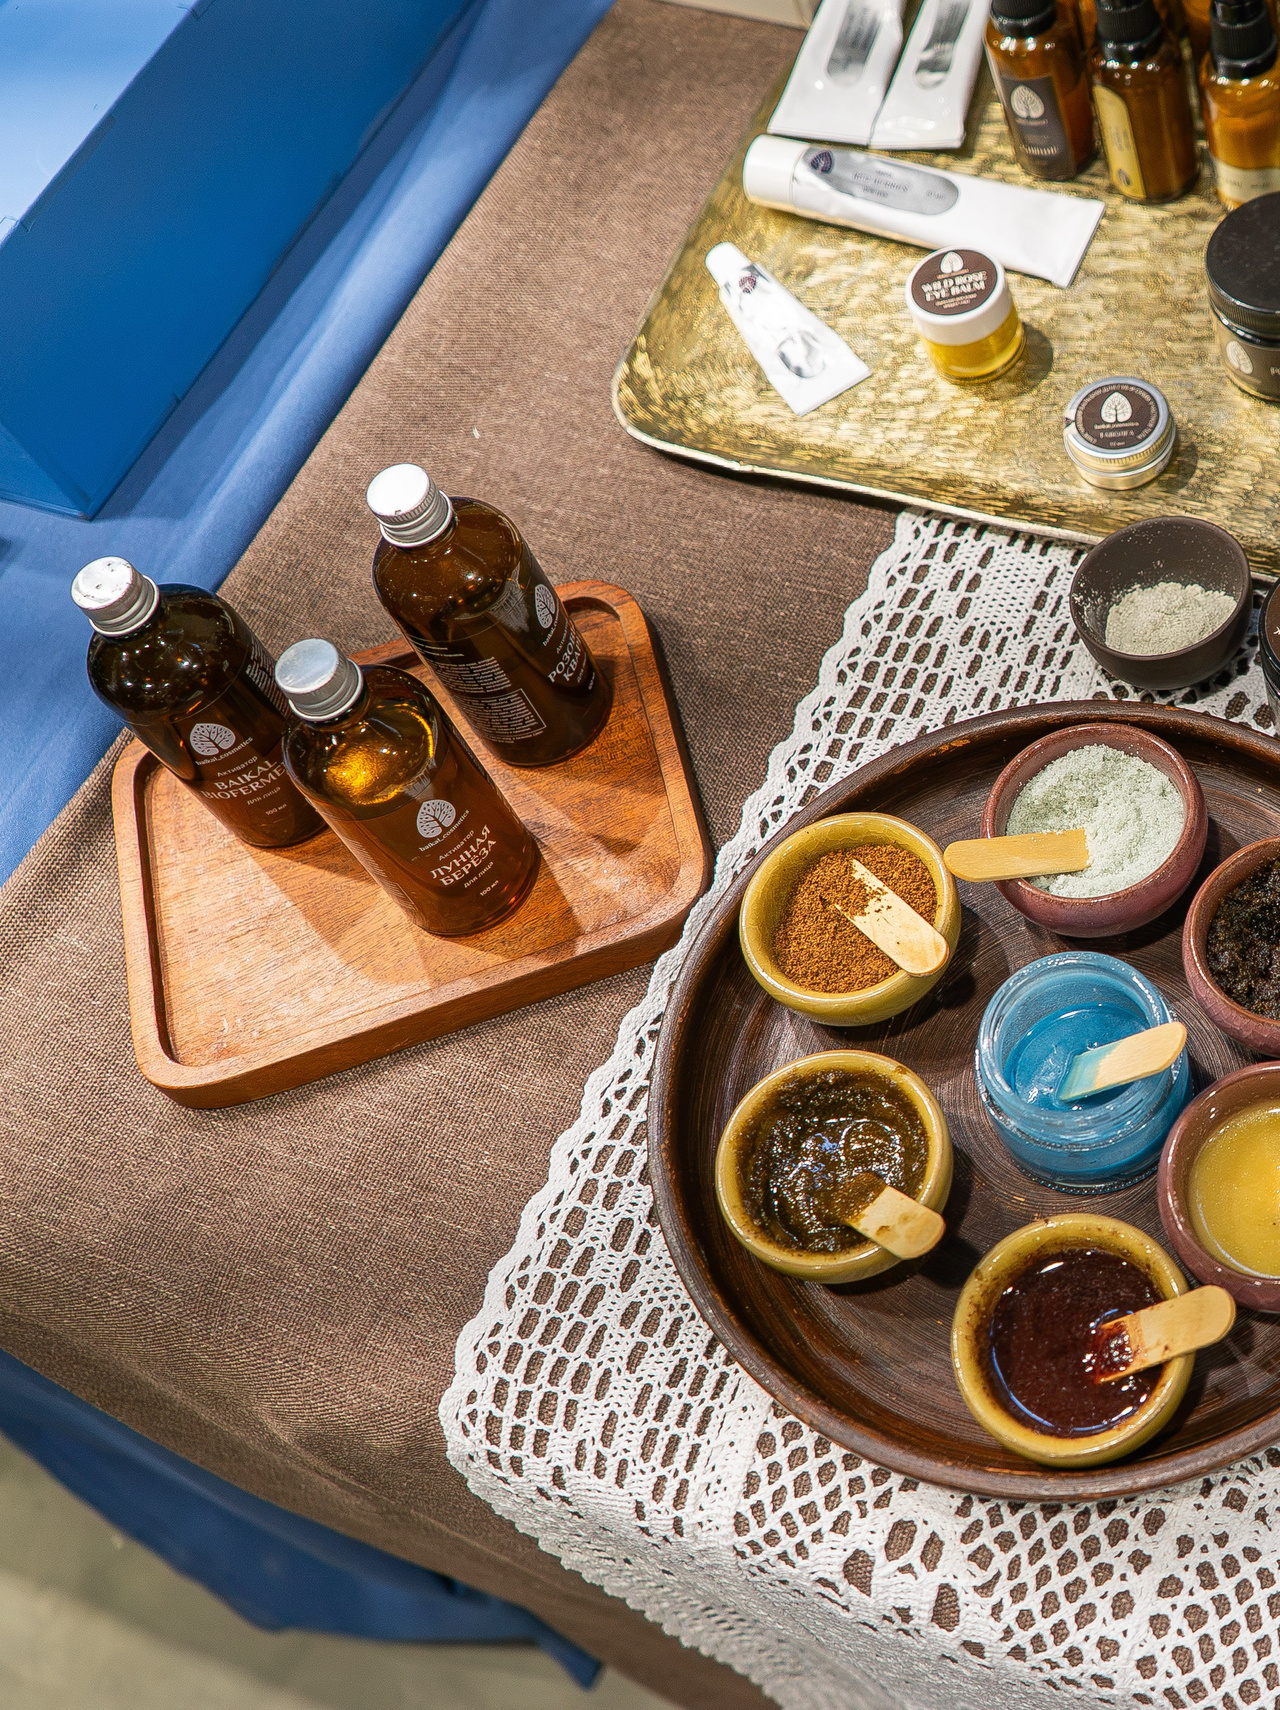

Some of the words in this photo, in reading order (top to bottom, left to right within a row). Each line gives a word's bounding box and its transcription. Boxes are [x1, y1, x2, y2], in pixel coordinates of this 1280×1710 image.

[921, 278, 955, 293] WILD
[955, 271, 988, 286] ROSE
[950, 280, 986, 296] BALM
[201, 762, 287, 800] BIOFERME
[214, 760, 278, 790] BAIKAL
[217, 756, 258, 777] Активатор
[247, 796, 262, 806] для
[418, 809, 470, 852] baikal_cosmetics
[430, 824, 491, 879] ЛУННАЯ
[439, 830, 474, 861] Активатор
[440, 840, 497, 886] БЕРЁЗА
[464, 876, 478, 889] для
[478, 861, 494, 878] лица
[480, 886, 491, 897] 100
